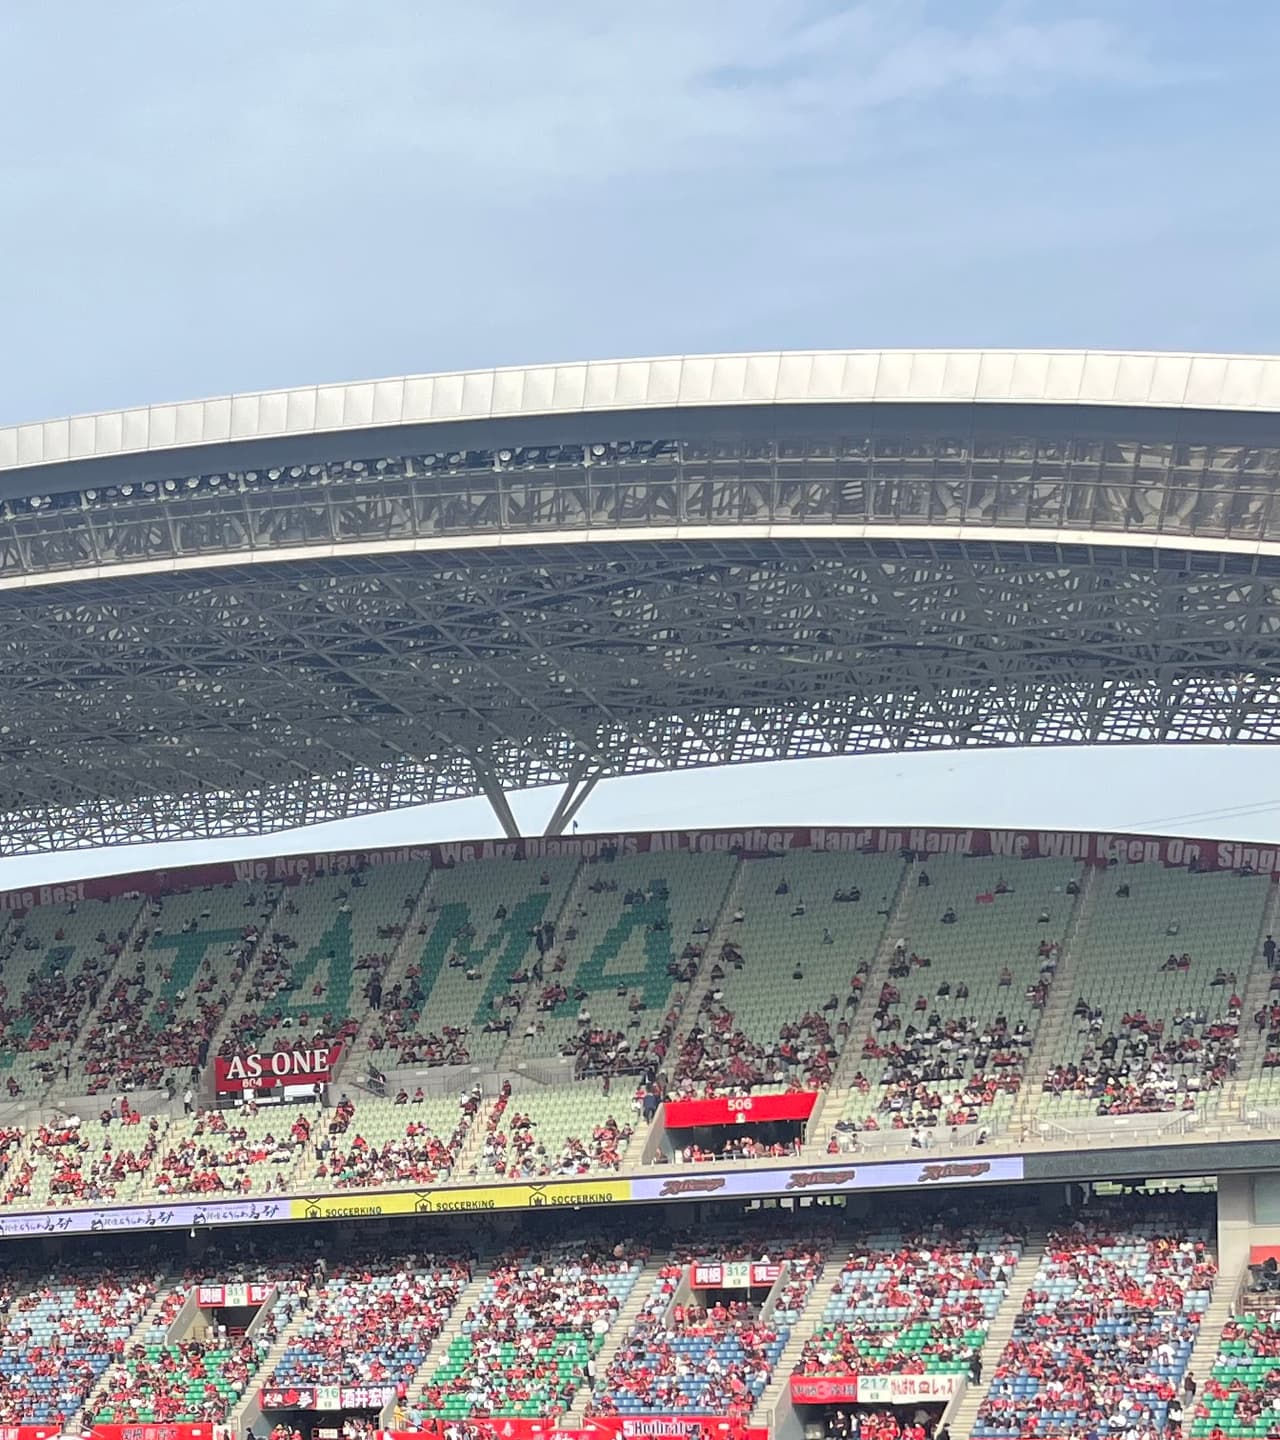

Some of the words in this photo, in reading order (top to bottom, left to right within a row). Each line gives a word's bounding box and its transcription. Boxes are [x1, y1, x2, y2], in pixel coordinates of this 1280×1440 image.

[648, 831, 681, 852] All
[910, 830, 973, 855] Hand
[990, 831, 1031, 858] We
[233, 858, 269, 881] We
[273, 856, 309, 877] Are
[440, 841, 477, 864] We
[482, 839, 517, 860] Are
[31, 882, 86, 906] Best
[228, 1053, 263, 1081] AS
[272, 1048, 330, 1077] ONE
[727, 1097, 753, 1111] 506
[551, 1193, 613, 1205] SOCCERKING
[326, 1206, 382, 1217] SOCCERKING
[437, 1200, 495, 1211] SOCCERKING
[727, 1267, 748, 1276] 312
[227, 1287, 245, 1296] 311
[860, 1378, 888, 1390] 217
[317, 1388, 338, 1399] 216
